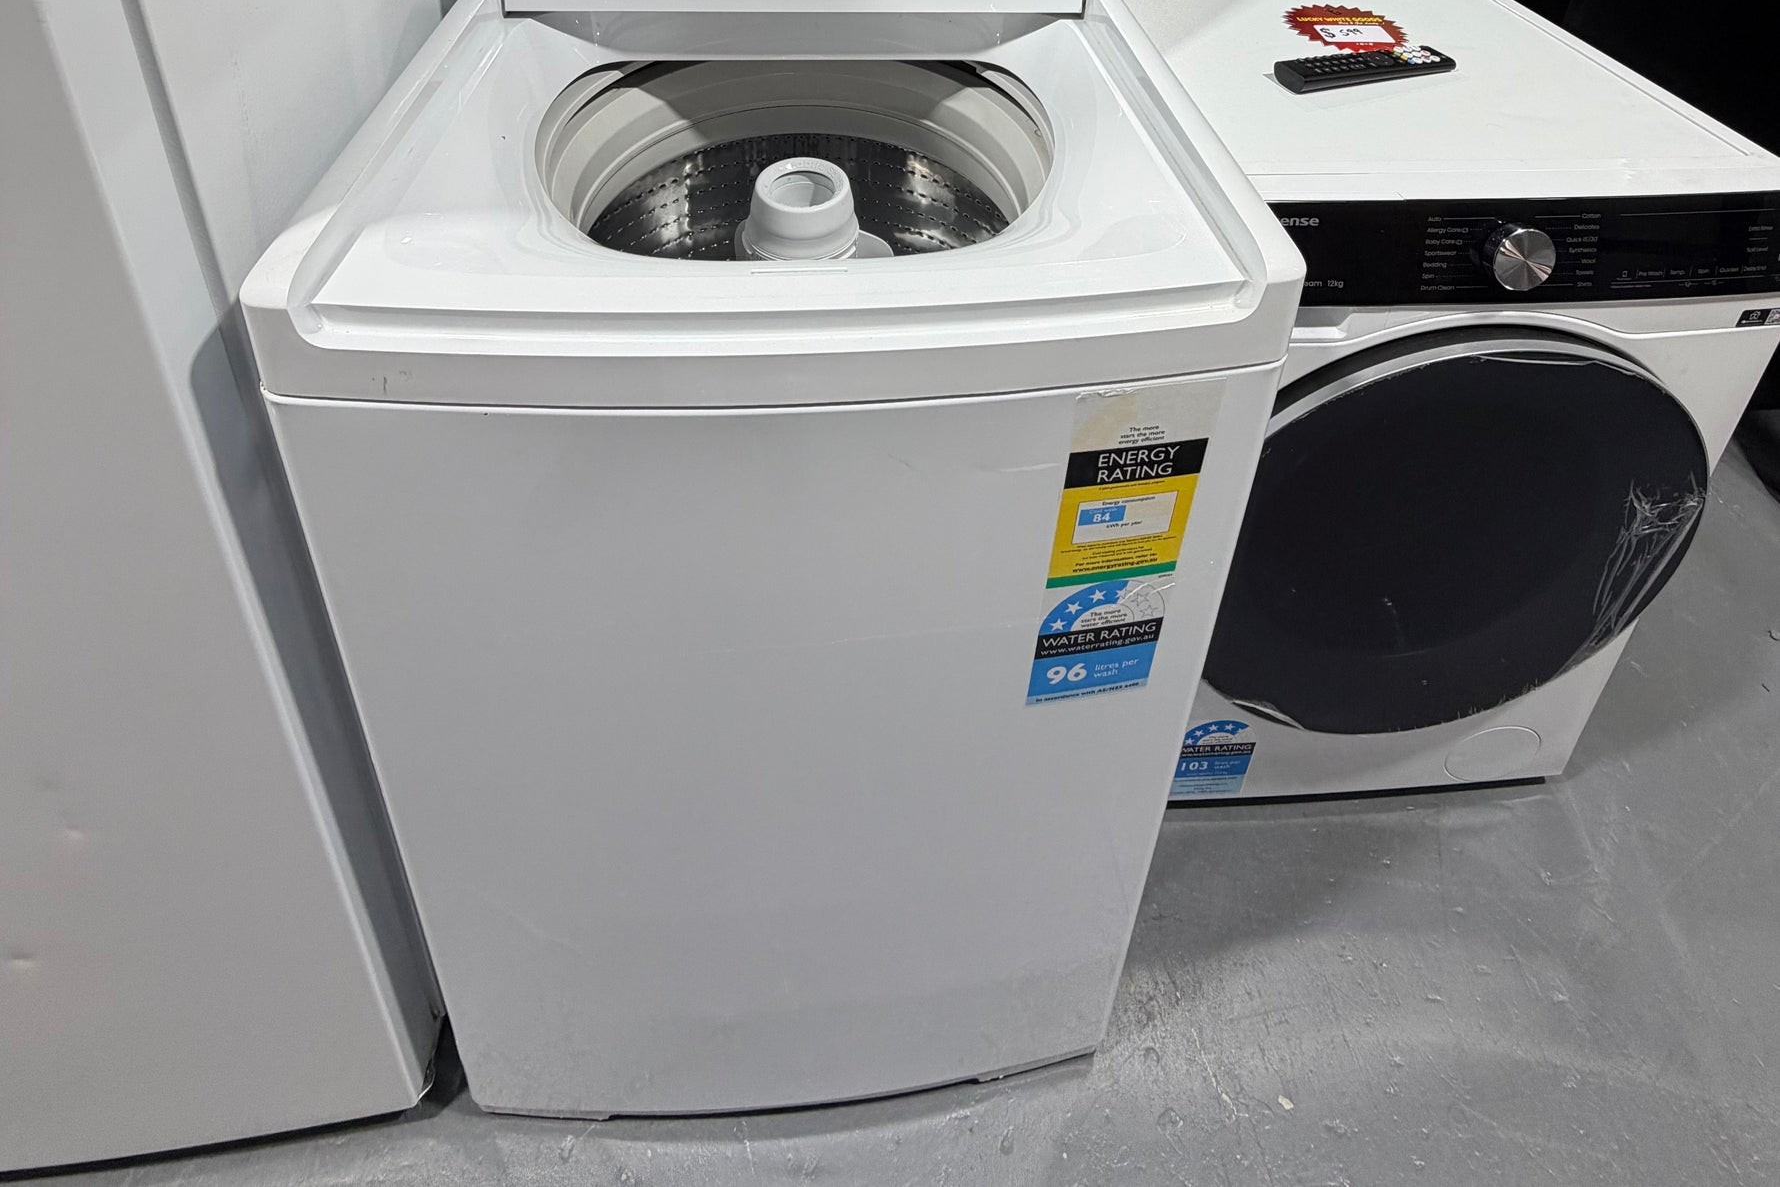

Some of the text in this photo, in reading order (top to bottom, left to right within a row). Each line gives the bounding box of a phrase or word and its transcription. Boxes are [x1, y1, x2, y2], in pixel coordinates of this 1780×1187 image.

[1098, 445, 1180, 467] ENERGY
[1097, 462, 1173, 483] RATING
[1092, 512, 1111, 523] 84
[1040, 634, 1155, 656] www.waterrating.gov.au
[1042, 622, 1157, 647] WATER RATING
[1046, 663, 1087, 685] 96
[1093, 669, 1118, 678] wash
[1095, 658, 1139, 671] litres per
[1180, 761, 1209, 771] 103
